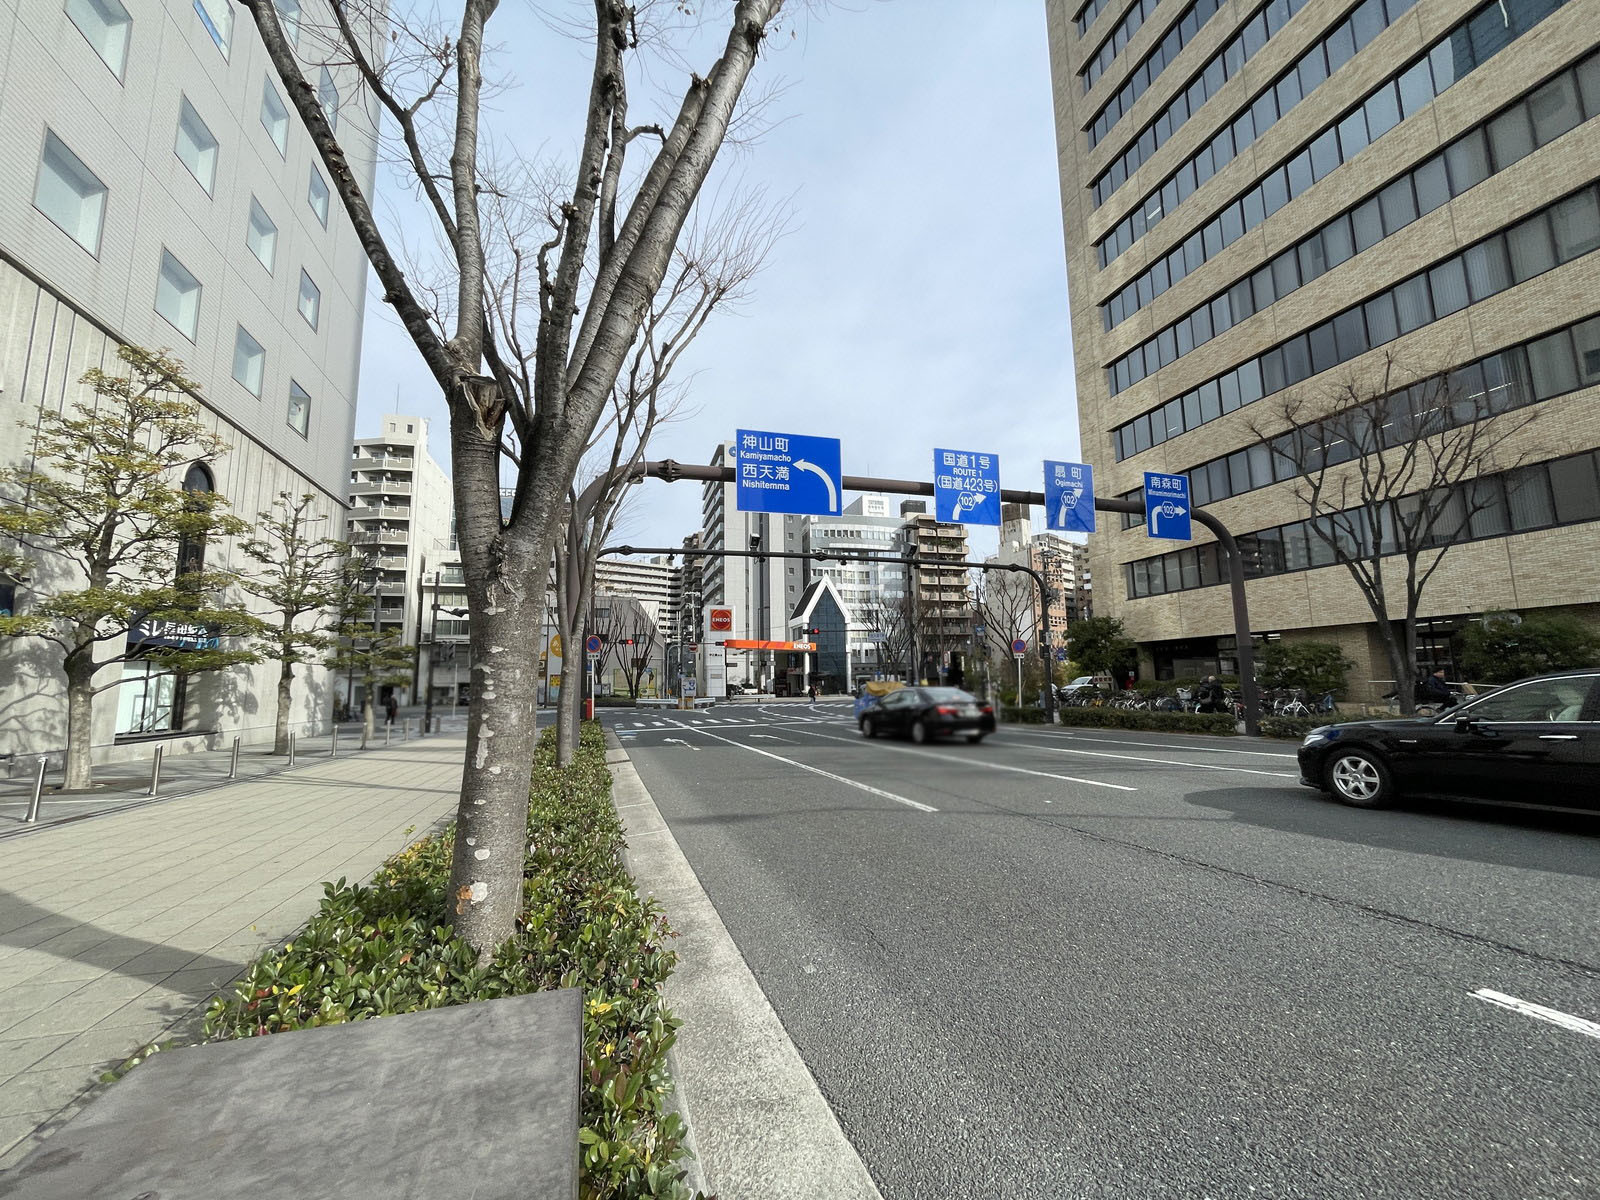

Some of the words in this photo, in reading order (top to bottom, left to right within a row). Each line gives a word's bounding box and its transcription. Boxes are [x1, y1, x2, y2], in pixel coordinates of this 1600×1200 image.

[742, 434, 789, 452] 神山町
[740, 450, 792, 463] Kamiyamacho
[943, 452, 991, 469] 国道1号
[742, 463, 790, 481] 西天満
[953, 468, 977, 477] ROUTE
[742, 479, 790, 491] Nishitemma
[937, 475, 998, 493] (国道423号)
[1055, 479, 1083, 488] Ogimachi
[1150, 476, 1182, 491] 南森町
[960, 496, 973, 506] 102
[1063, 495, 1075, 504] 102
[1163, 505, 1174, 515] 102
